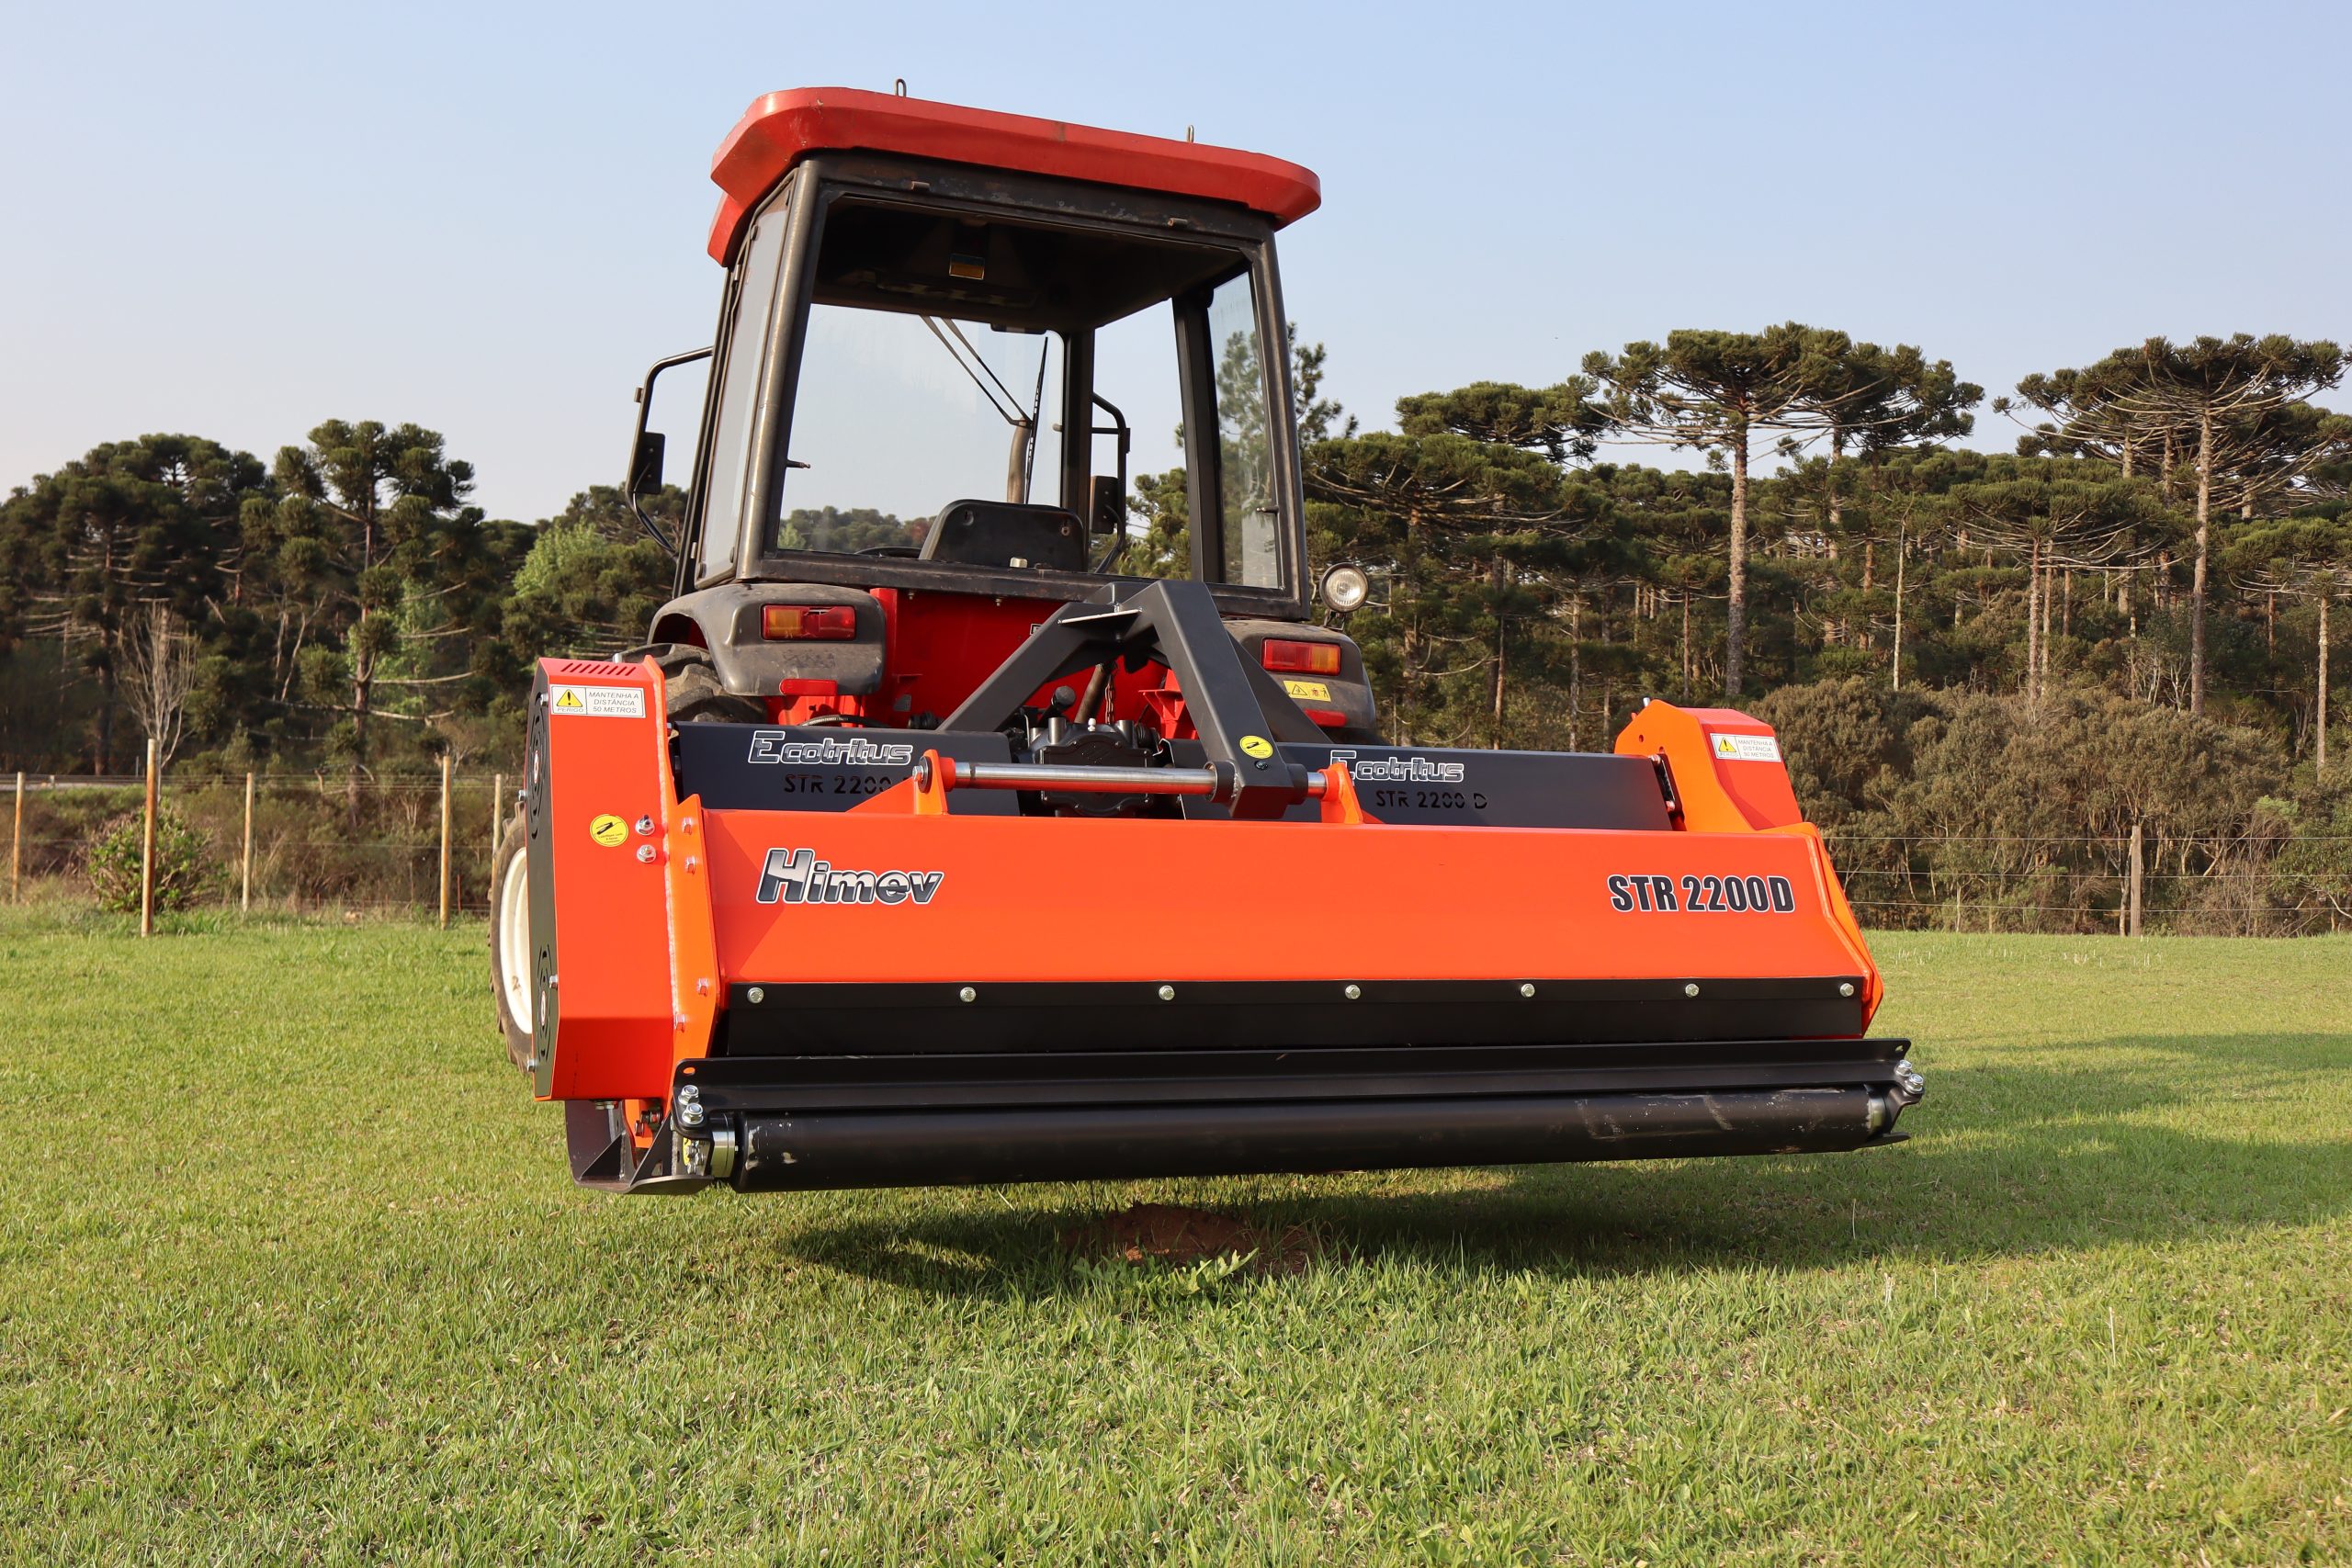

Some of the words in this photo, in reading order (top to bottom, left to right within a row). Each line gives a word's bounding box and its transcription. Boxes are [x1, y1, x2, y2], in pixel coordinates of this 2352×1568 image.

[748, 730, 913, 765] Ecotritus
[784, 773, 824, 794] STR
[1375, 790, 1409, 807] STR
[1417, 791, 1465, 808] 2200
[1473, 792, 1487, 809] D
[756, 847, 944, 905] Himev
[1607, 874, 1679, 912] STR
[1680, 874, 1795, 913] 2200D
